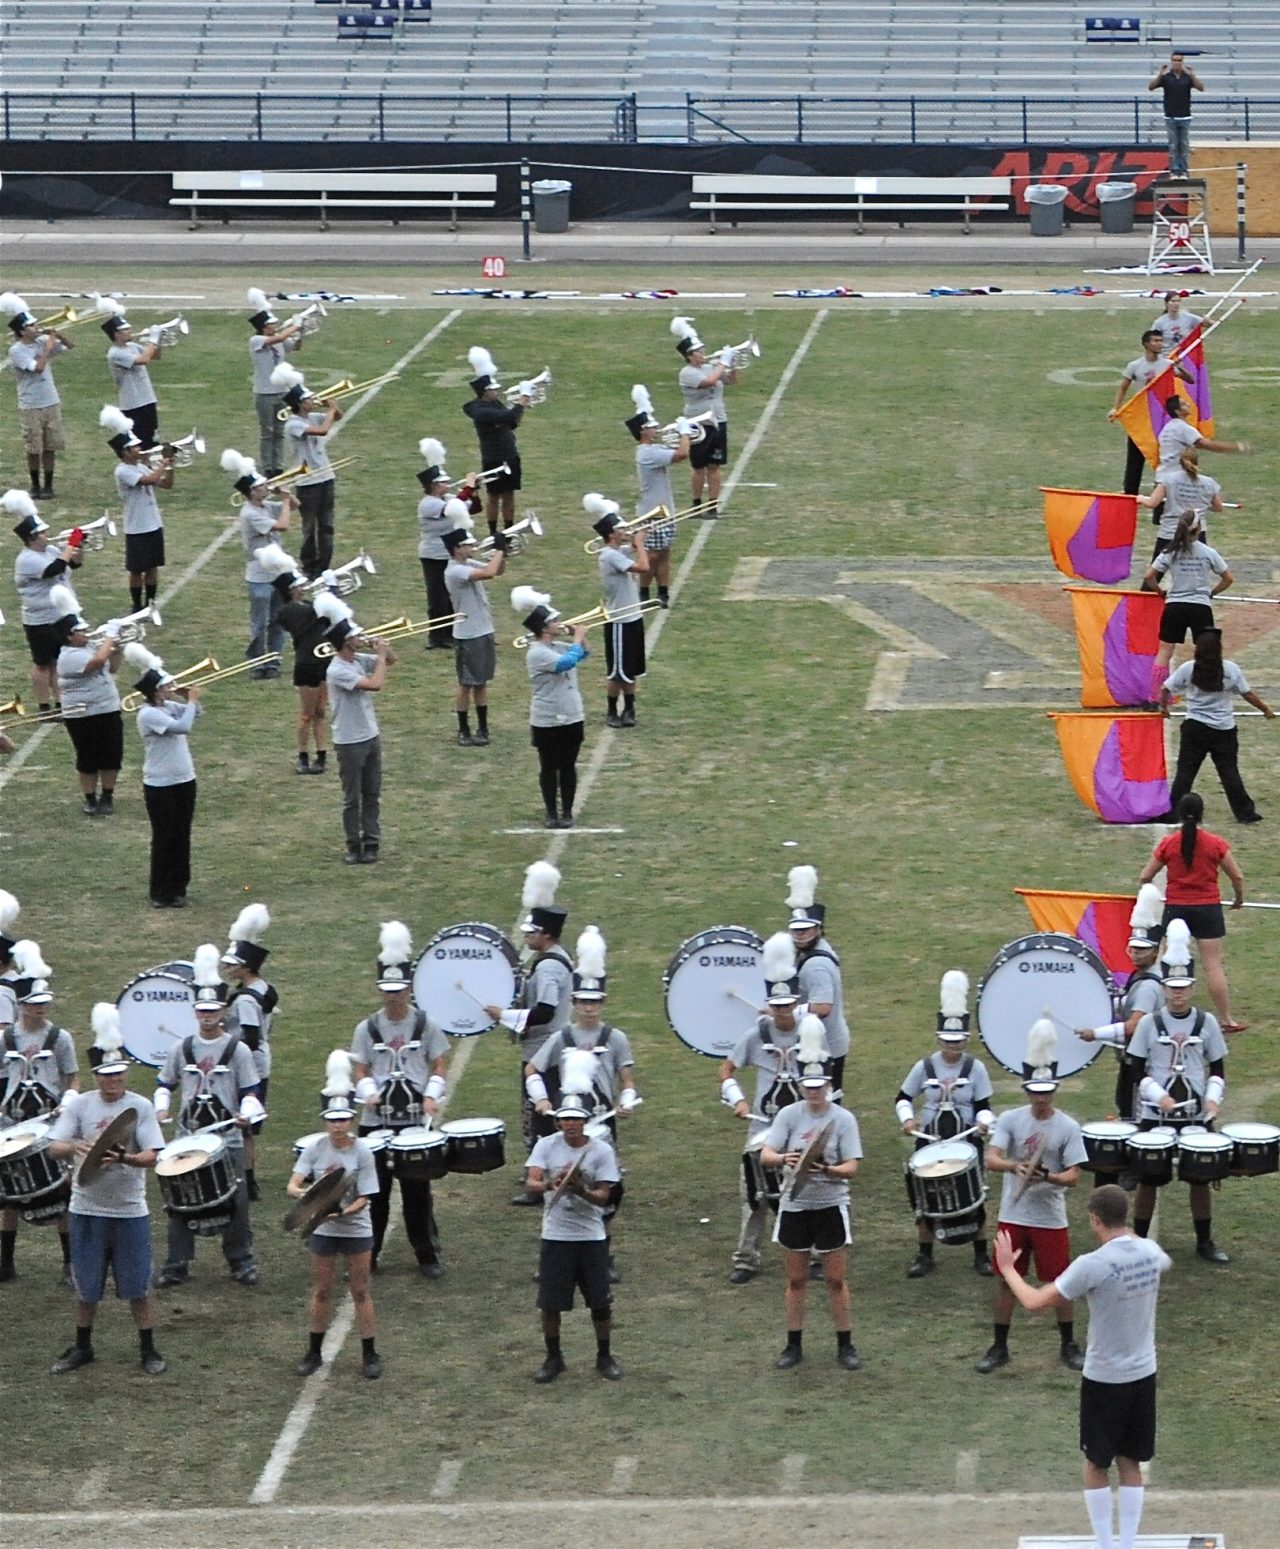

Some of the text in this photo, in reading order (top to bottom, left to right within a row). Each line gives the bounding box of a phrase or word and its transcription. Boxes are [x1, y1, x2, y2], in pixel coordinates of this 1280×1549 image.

[1170, 222, 1189, 240] 50
[483, 257, 505, 276] 40
[447, 948, 492, 960] YAMAHA
[713, 956, 757, 968] YAMAHA
[1032, 962, 1076, 974] YAMAHA
[146, 991, 190, 1002] YAMAHA
